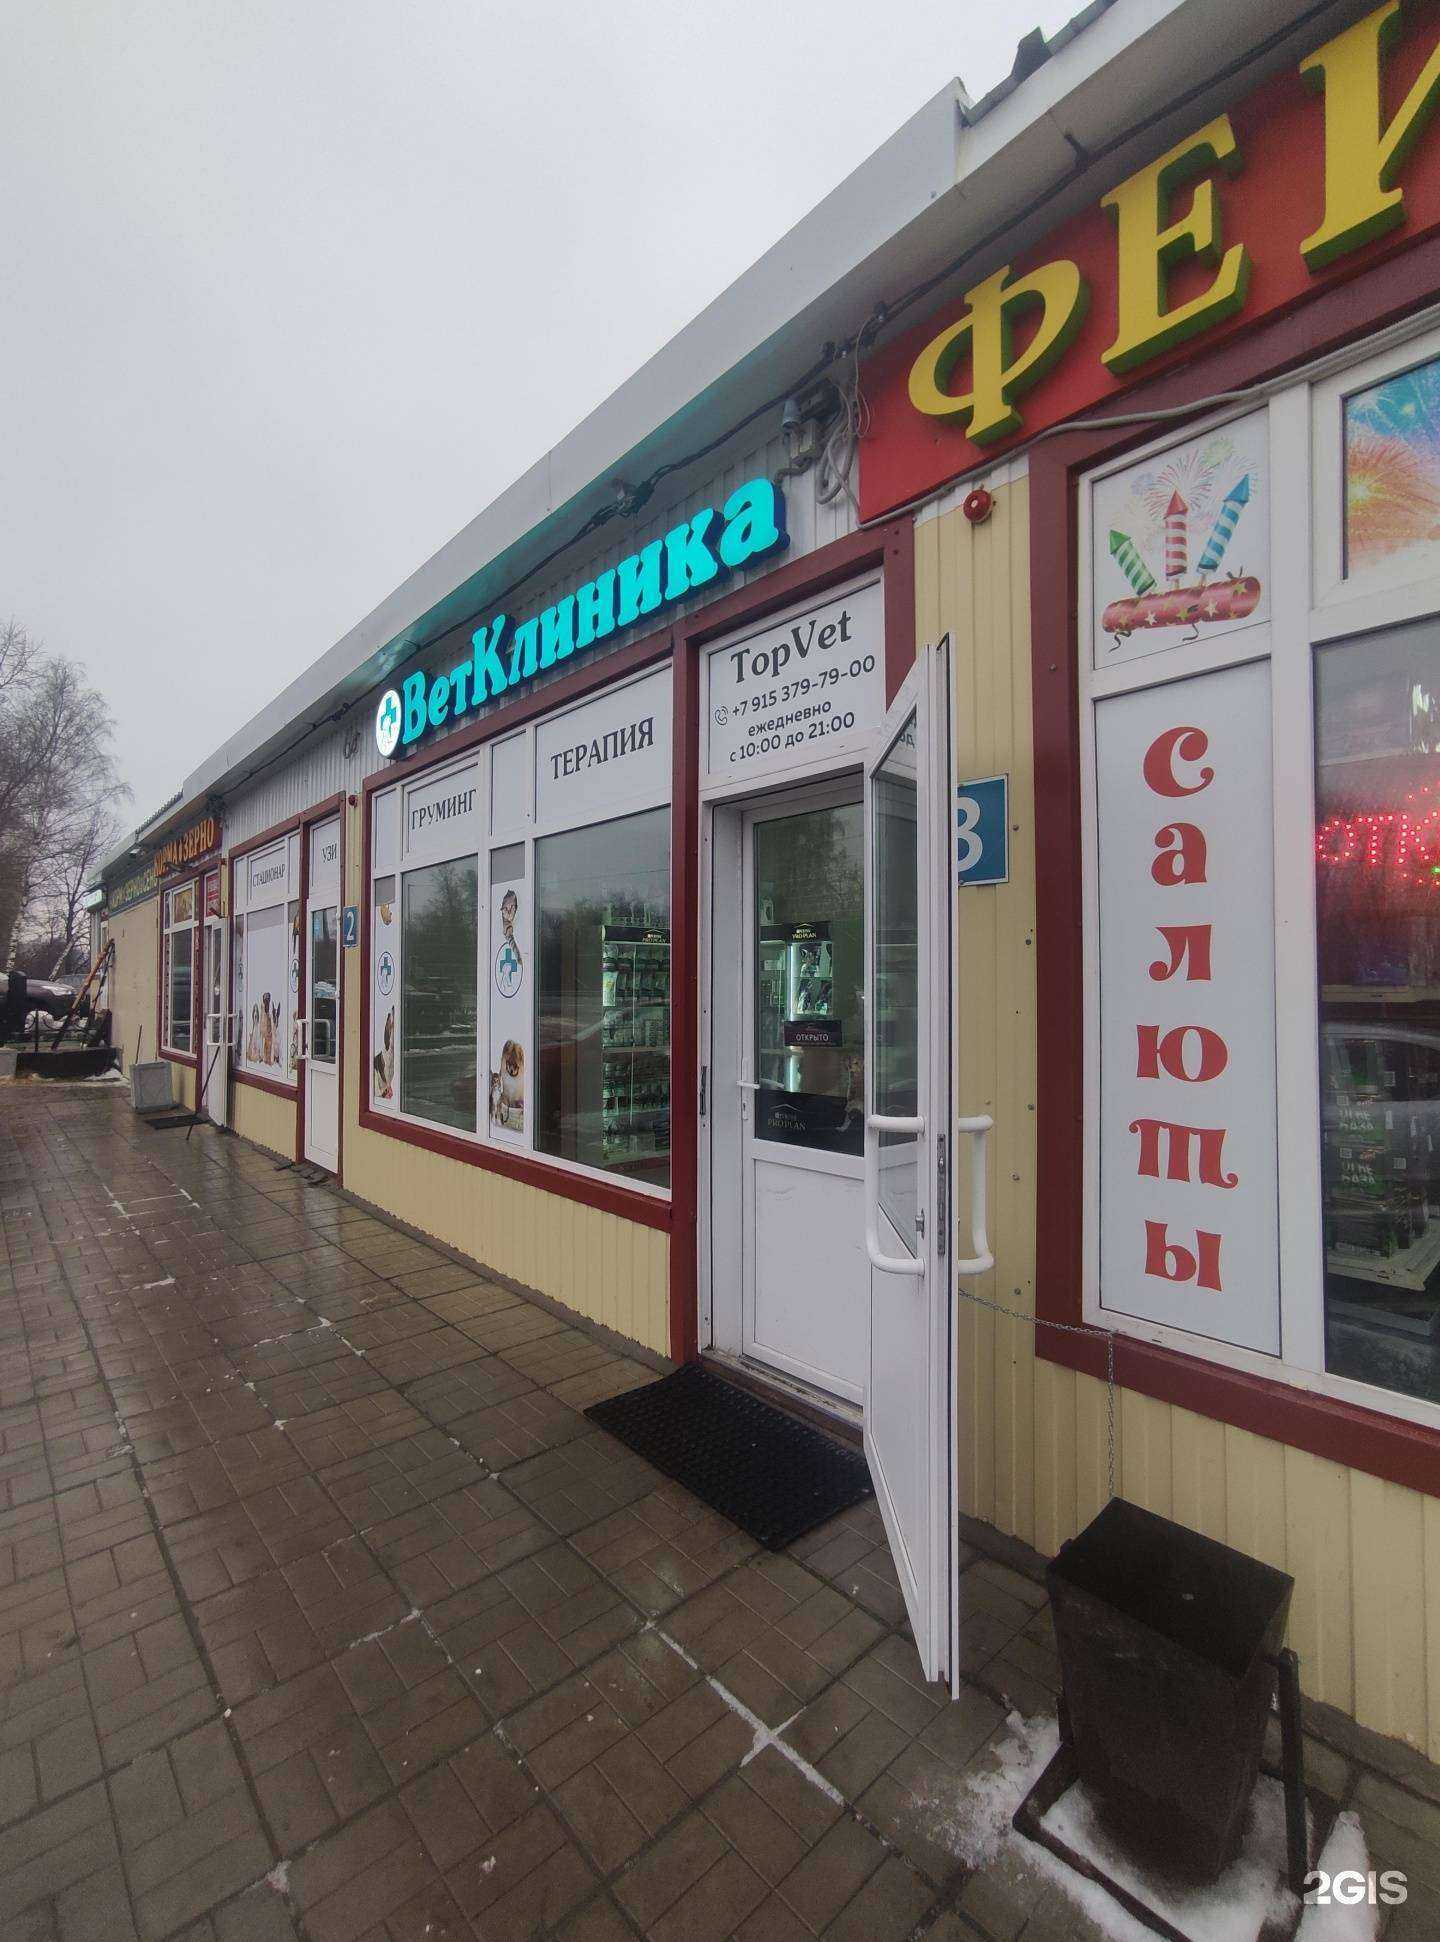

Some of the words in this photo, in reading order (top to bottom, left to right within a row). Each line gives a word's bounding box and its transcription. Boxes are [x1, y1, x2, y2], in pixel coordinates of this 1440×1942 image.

[401, 477, 783, 745] ВетКлиника
[730, 610, 852, 684] TopVet
[732, 700, 748, 717] +7
[752, 690, 778, 713] 915
[781, 654, 875, 702] 379-79-00
[740, 734, 781, 760] 10:00
[785, 731, 804, 748] до
[808, 711, 855, 740] 21:00
[748, 700, 832, 737] ежедневно
[550, 716, 654, 780] ТЕРАПИЯ
[411, 788, 478, 830] ГРУМИНГ
[322, 843, 337, 863] УЗИ
[252, 863, 286, 888] СТАЦИОНАР
[346, 911, 355, 941] 2
[795, 1033, 829, 1042] ОТКРЫТО
